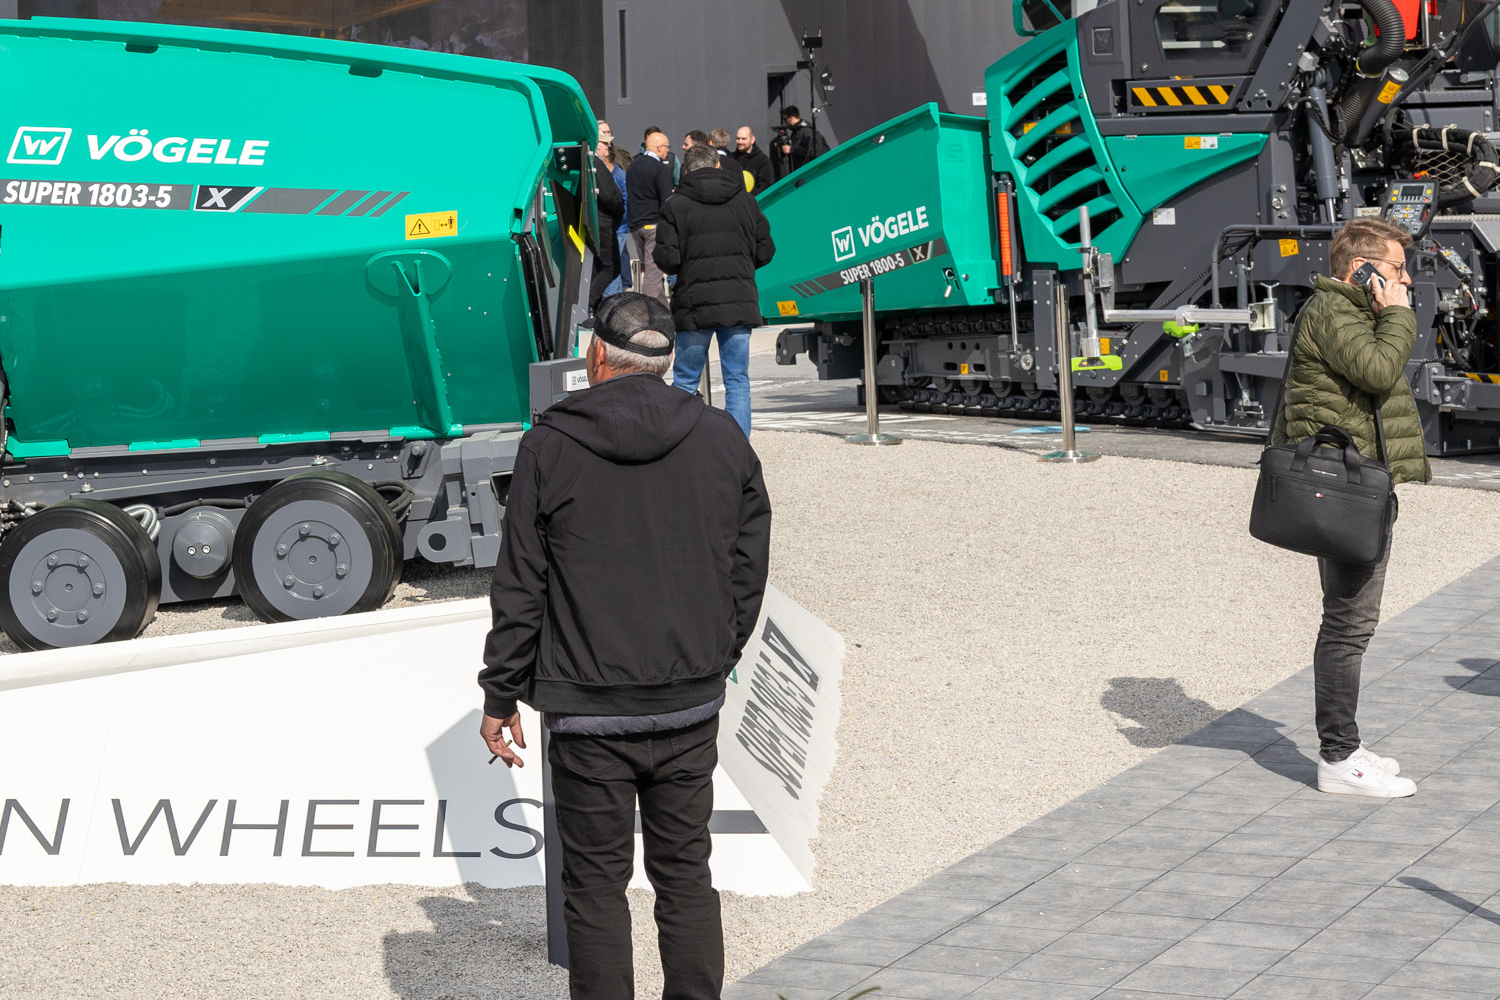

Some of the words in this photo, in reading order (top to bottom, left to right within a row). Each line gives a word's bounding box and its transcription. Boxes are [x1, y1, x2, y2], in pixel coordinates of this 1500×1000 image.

[87, 128, 270, 166] VÖGELE
[3, 180, 81, 205] SUPER
[88, 183, 173, 208] 1803-5
[858, 205, 929, 247] VÖGELE
[840, 265, 872, 285] SUPER
[870, 252, 905, 276] 1800-5
[735, 699, 807, 800] SUPER
[110, 798, 545, 860] WHEELS
